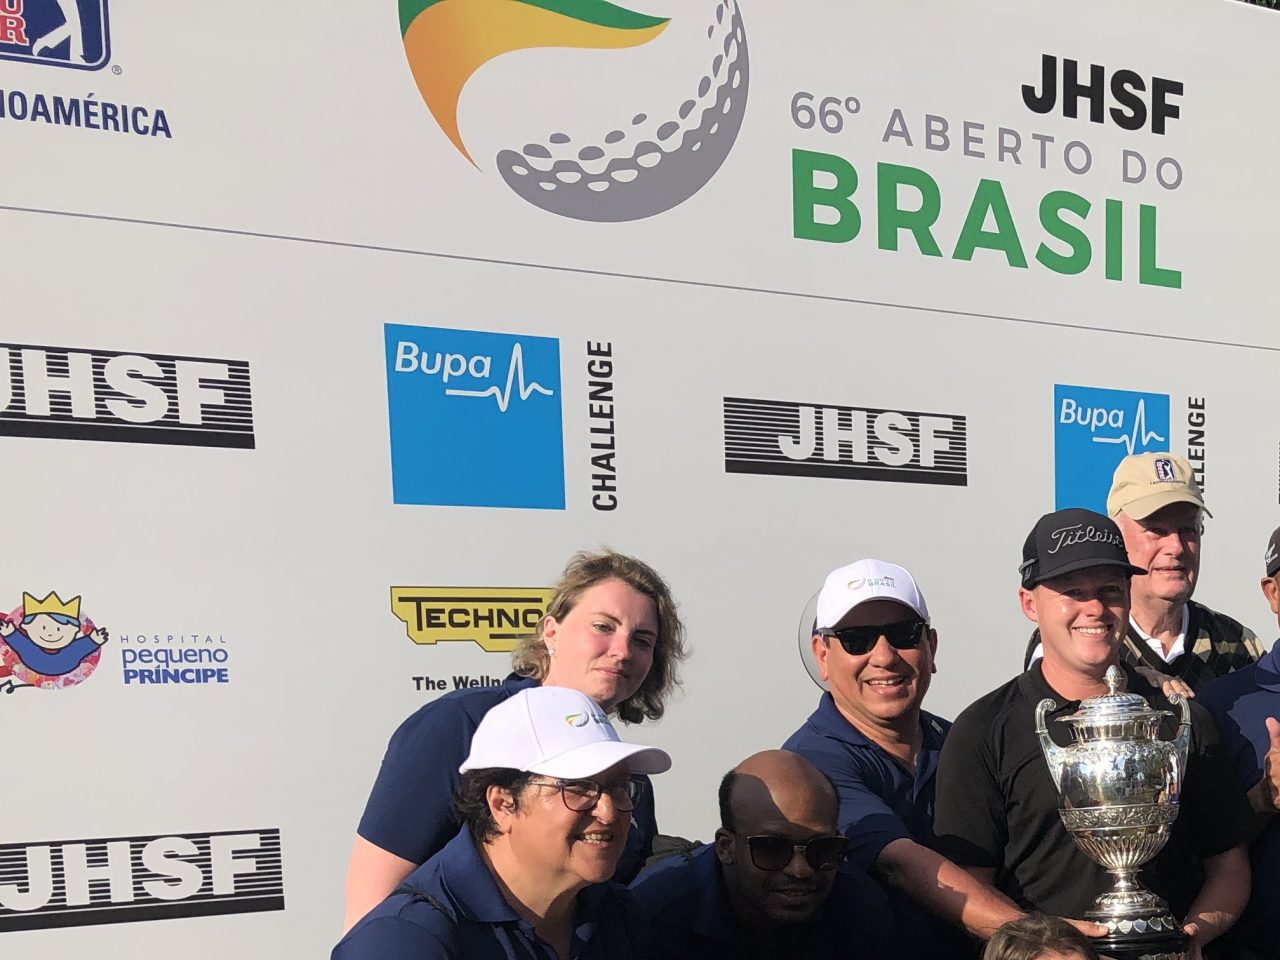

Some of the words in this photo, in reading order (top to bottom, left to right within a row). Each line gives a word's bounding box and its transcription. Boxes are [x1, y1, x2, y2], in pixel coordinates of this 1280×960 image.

[0, 90, 172, 139] OAMÉRICA
[1020, 54, 1184, 135] JHSF
[882, 108, 1092, 174] ABERTO
[1122, 150, 1182, 190] DO
[792, 148, 1182, 289] BRASIL
[395, 341, 491, 382] Bupa
[0, 347, 229, 425] HSF
[586, 341, 618, 511] CHALLENGE
[778, 402, 954, 468] JHSF
[1059, 398, 1124, 432] Bupa
[398, 596, 543, 631] TECHNO
[120, 635, 226, 643] HOSPITAL
[122, 648, 228, 668] pequeno
[123, 665, 229, 684] PRÍNCIPE
[412, 677, 447, 691] The
